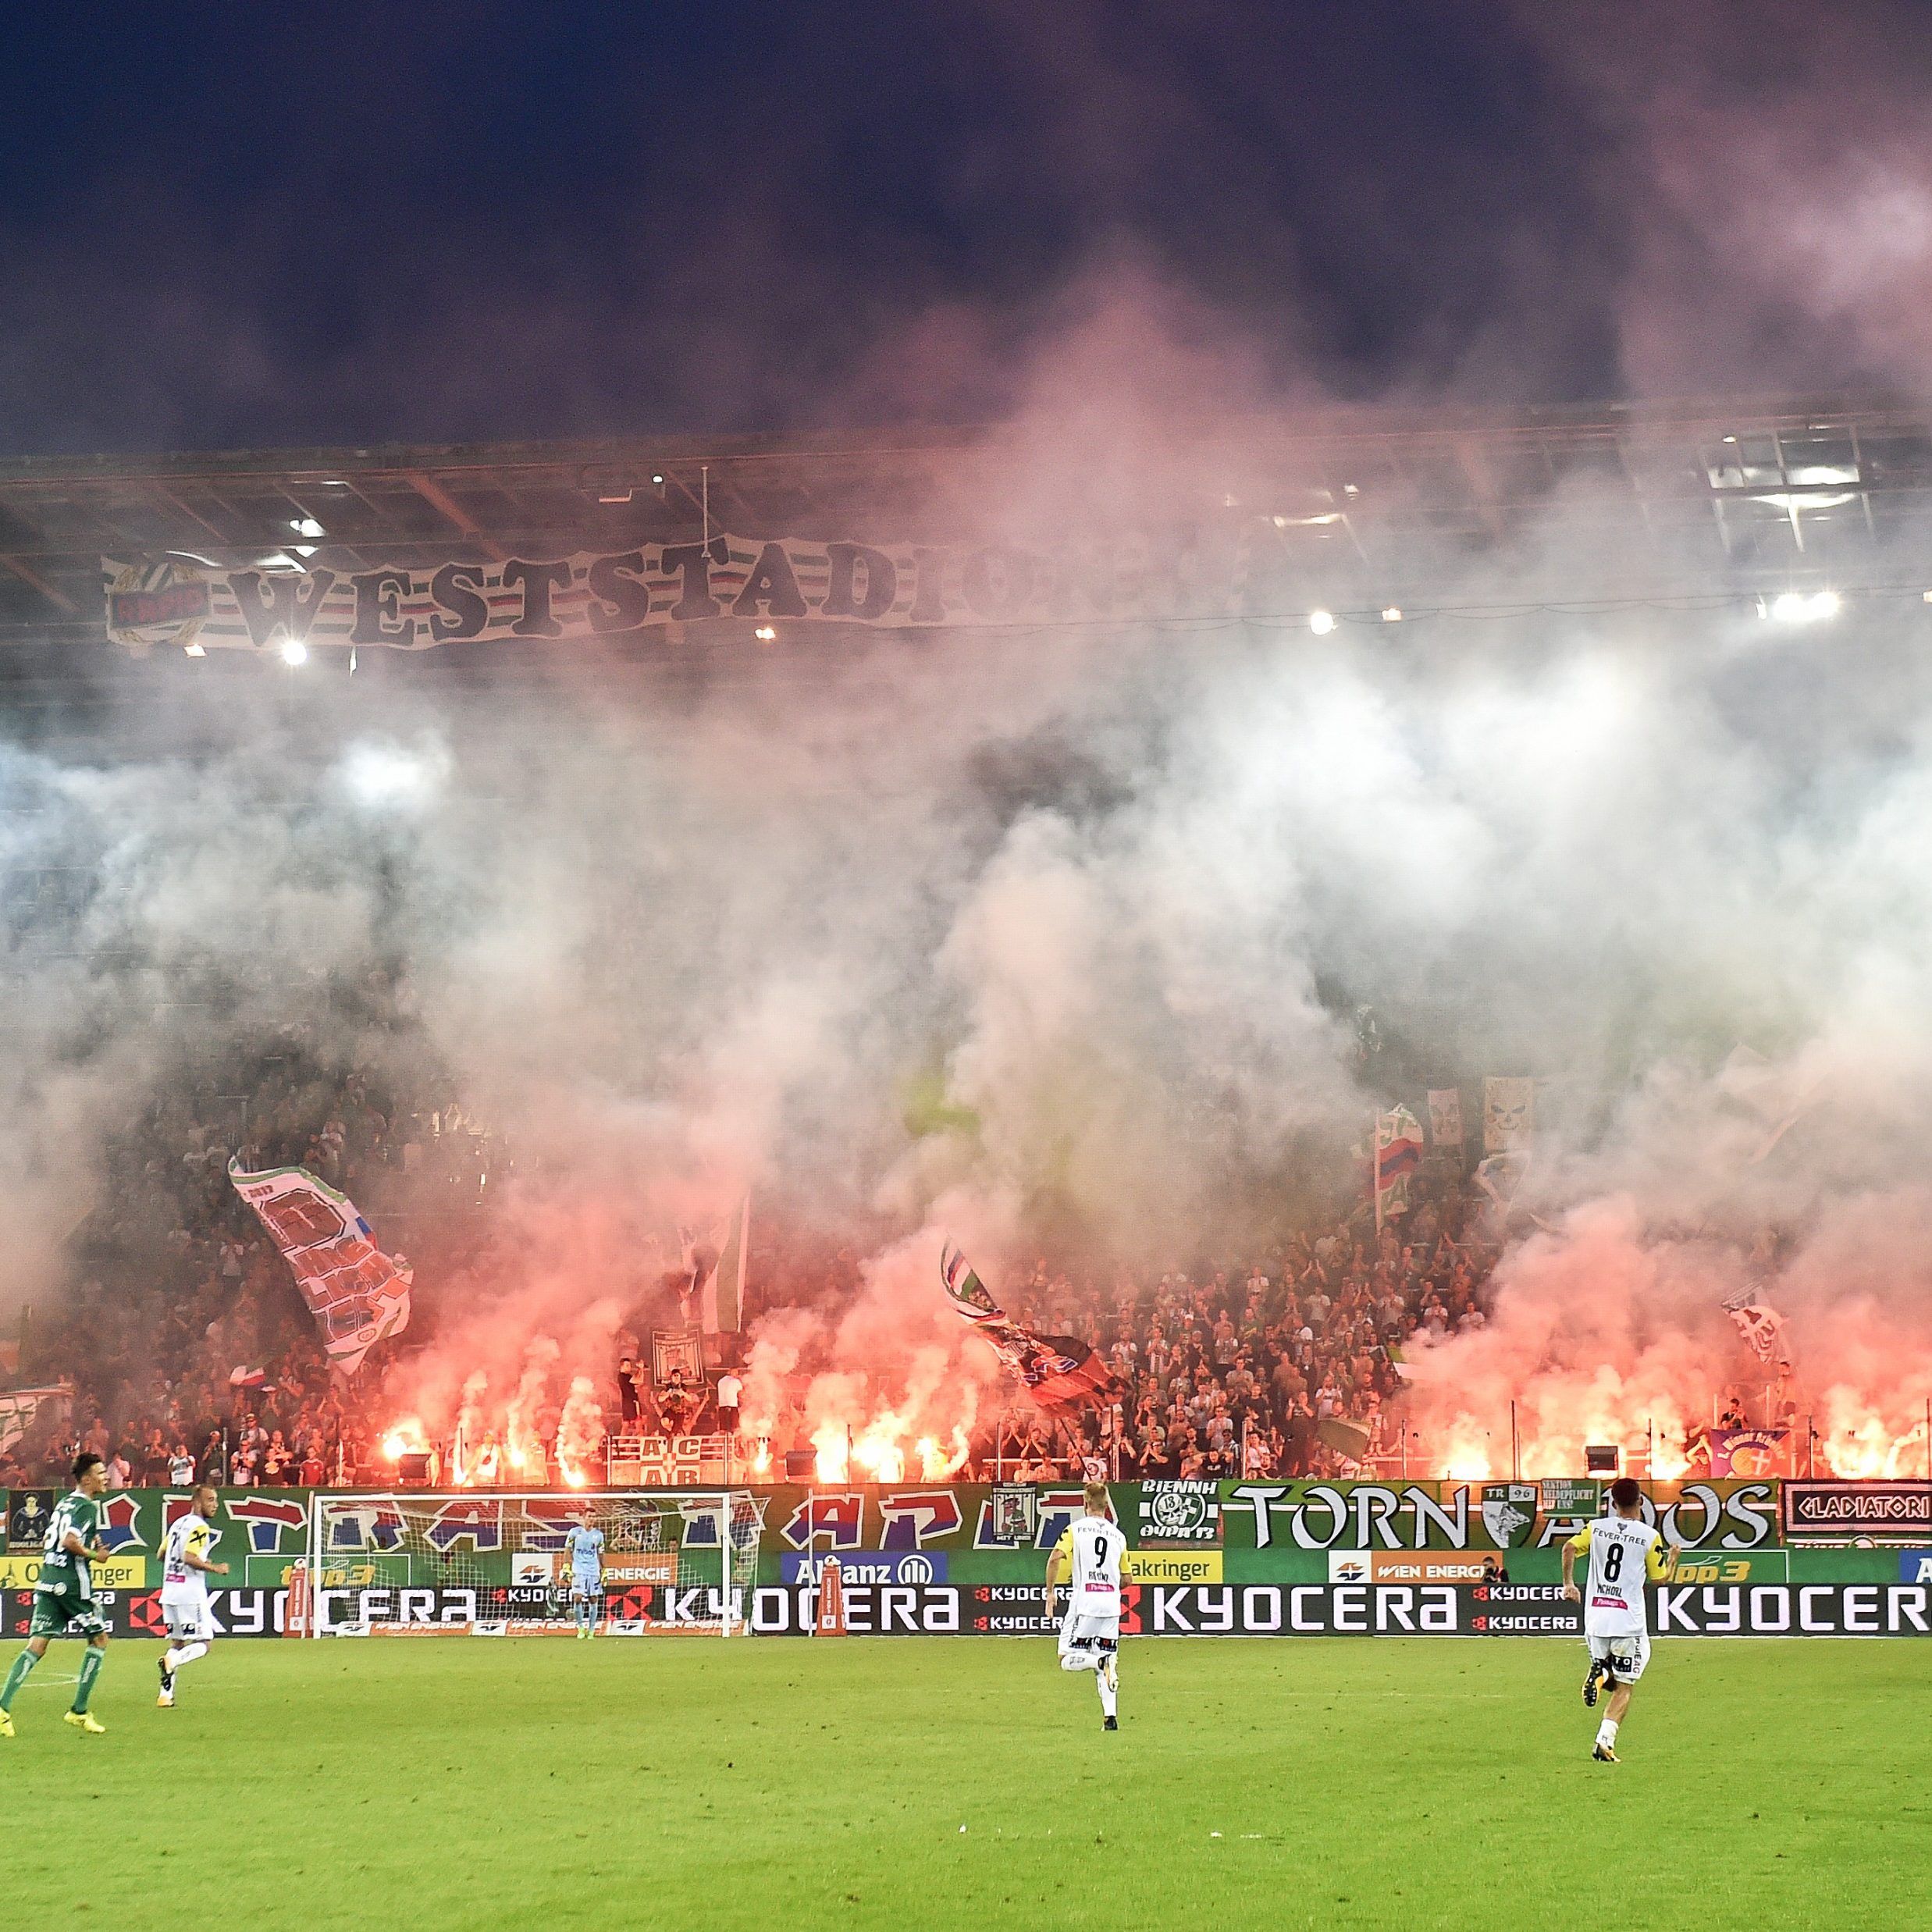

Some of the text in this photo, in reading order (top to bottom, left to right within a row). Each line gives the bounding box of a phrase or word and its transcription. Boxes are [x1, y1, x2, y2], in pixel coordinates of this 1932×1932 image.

[1486, 1489, 1530, 1499] TR 96
[1799, 1496, 1930, 1519] GLADIATORI
[1094, 1535, 1108, 1568] 9
[1604, 1543, 1624, 1582] 8
[280, 1564, 375, 1587] tpp3
[607, 1568, 670, 1581] ENERGIE
[795, 1560, 891, 1584] Alanz
[1132, 1559, 1210, 1581] akringer
[1378, 1566, 1485, 1578] WIEN ENERGI
[1489, 1586, 1566, 1600] KYOCER
[1657, 1587, 1931, 1631] KYOCER
[990, 1617, 1063, 1630] KYOCER
